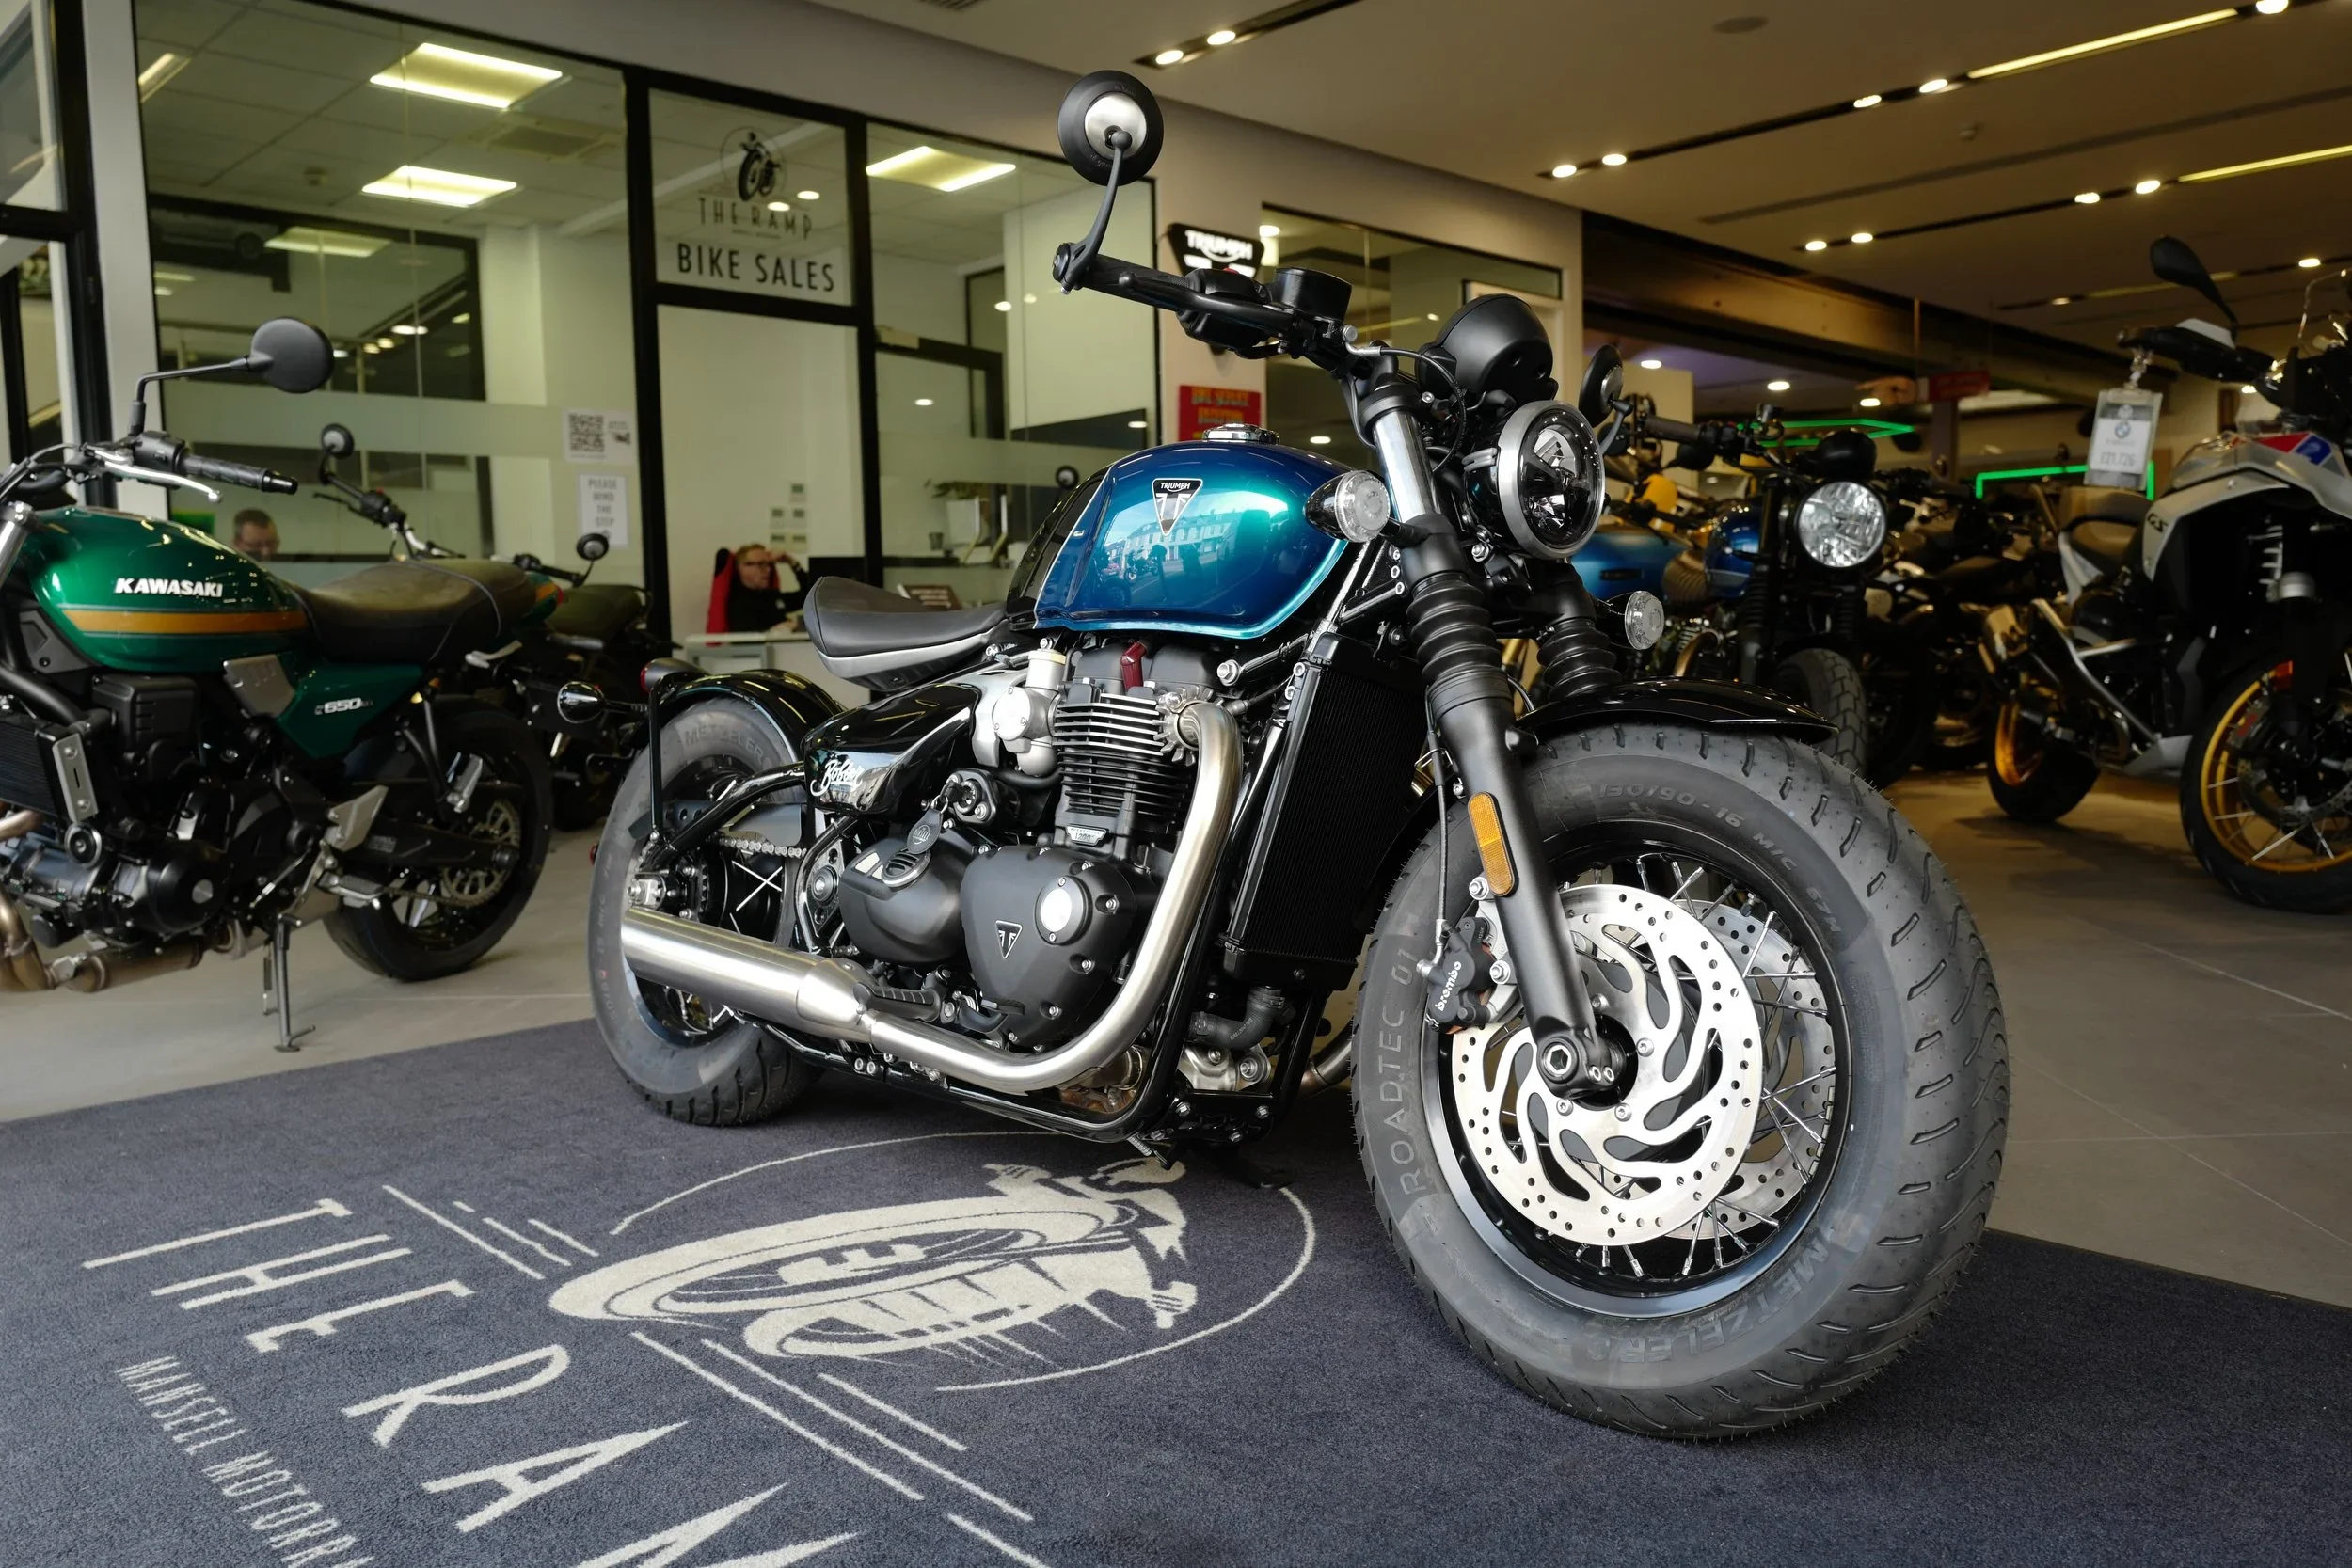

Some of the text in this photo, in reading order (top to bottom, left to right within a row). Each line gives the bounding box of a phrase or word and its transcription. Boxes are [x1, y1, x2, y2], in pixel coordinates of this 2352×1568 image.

[698, 198, 813, 240] THE RAMP
[676, 243, 834, 292] BIKE SALES
[1184, 230, 1253, 261] TRIUMPH
[1160, 482, 1191, 491] TRIUMPH
[115, 578, 223, 597] KAWASAKI
[1434, 960, 1463, 1012] brembo
[1378, 948, 1427, 1196] ROADTEC 01
[82, 1198, 474, 1354] THE
[1618, 1232, 1832, 1364] METZELER
[114, 1355, 248, 1456] MANSELL
